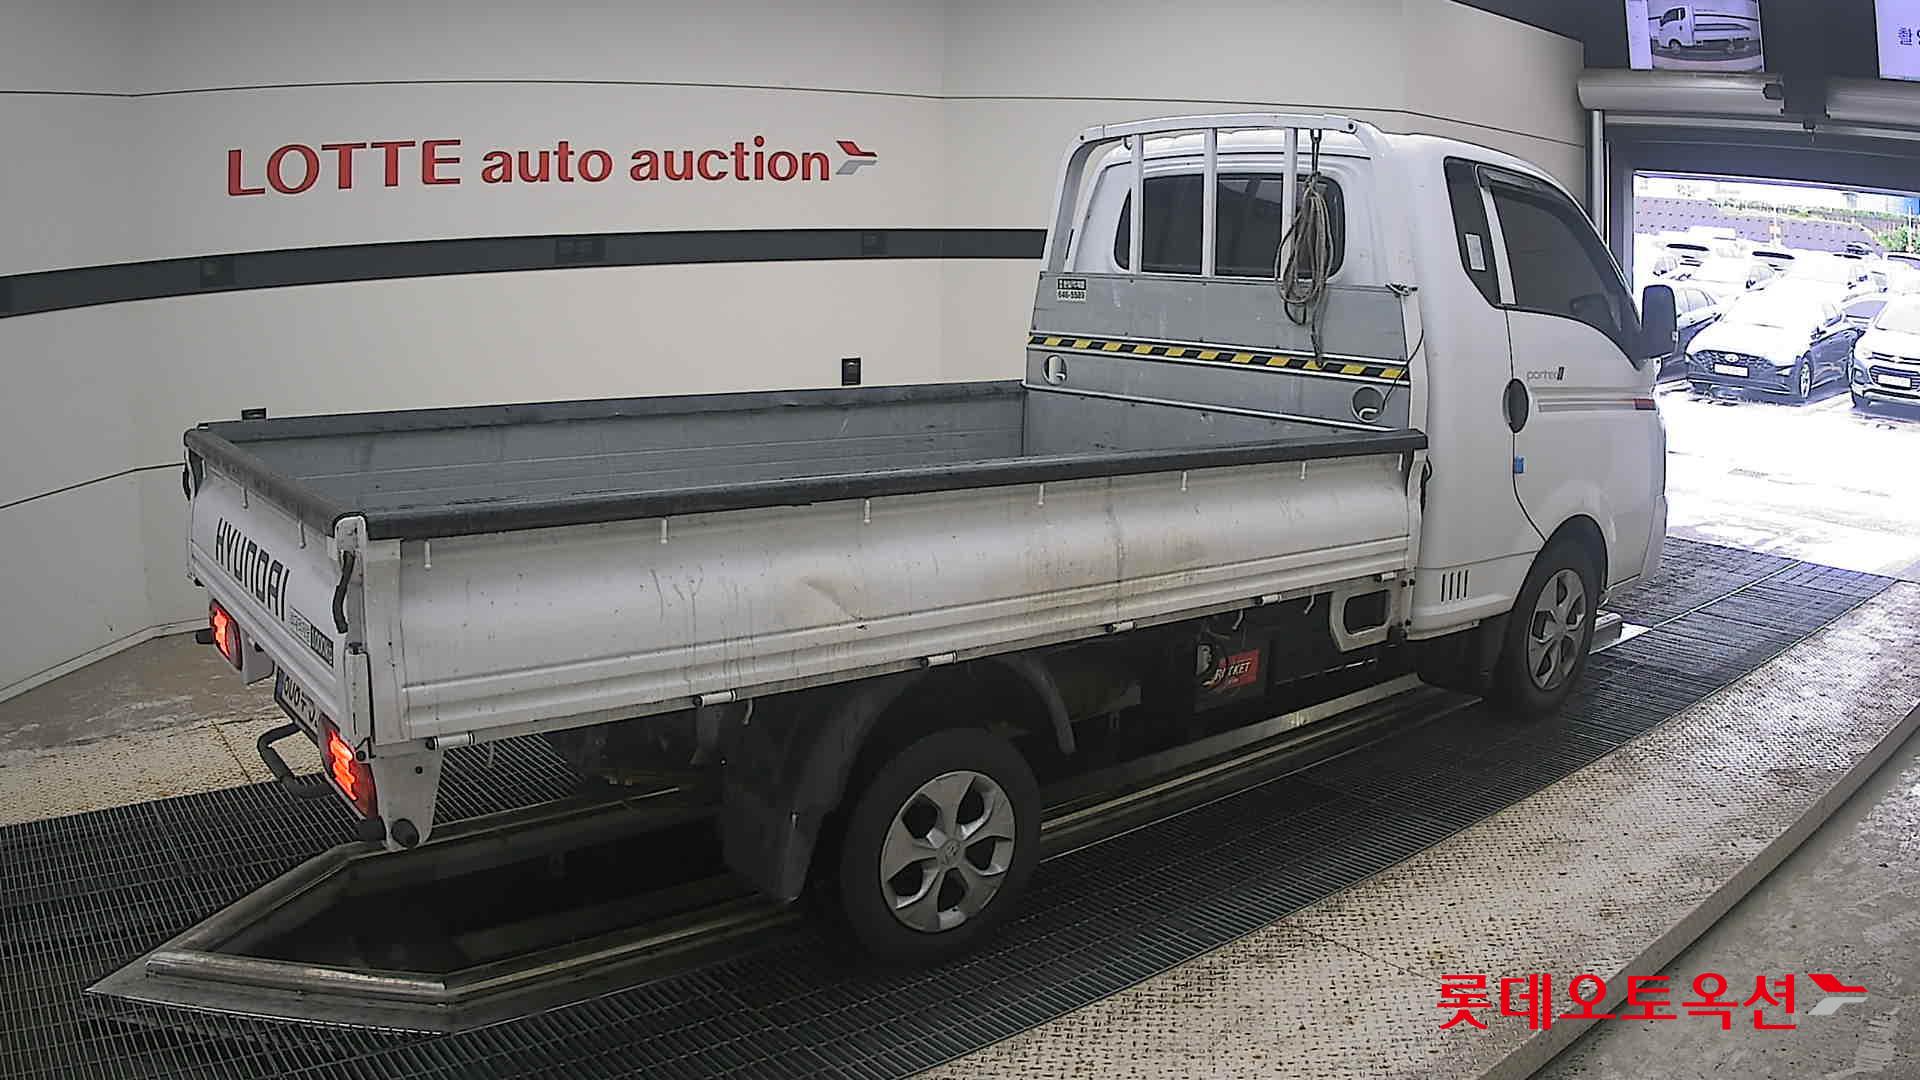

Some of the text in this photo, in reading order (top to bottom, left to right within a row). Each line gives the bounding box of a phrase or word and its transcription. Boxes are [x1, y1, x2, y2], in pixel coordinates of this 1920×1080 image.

[227, 136, 831, 196] LOTTE auto auction
[216, 517, 290, 622] HYUNDAI
